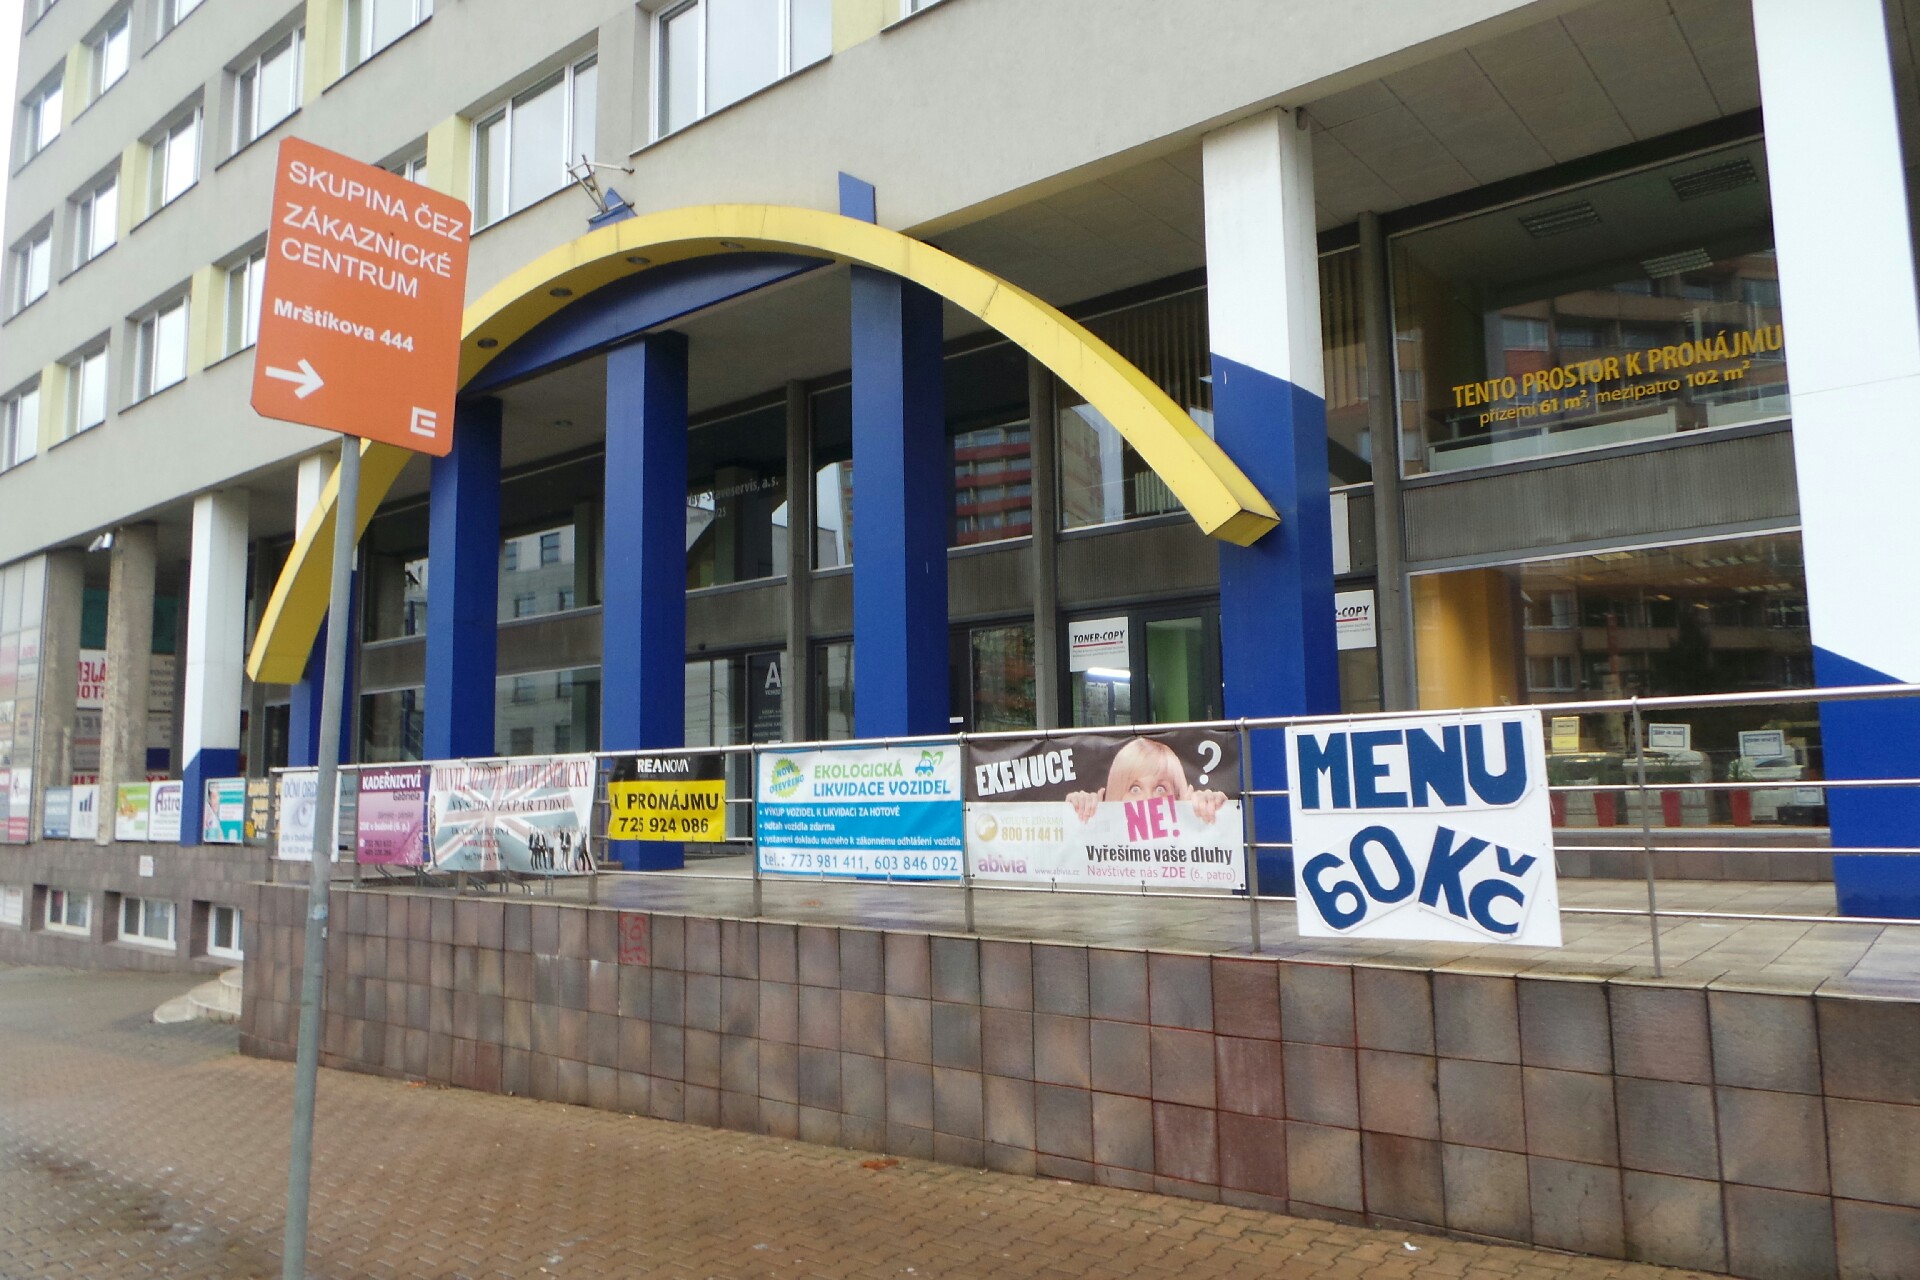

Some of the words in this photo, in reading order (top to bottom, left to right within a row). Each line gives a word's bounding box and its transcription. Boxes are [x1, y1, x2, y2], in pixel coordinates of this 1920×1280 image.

[289, 161, 408, 222] SKUPINA
[415, 203, 463, 242] ČEZ
[282, 202, 451, 278] ZÁKAZNICKÉ
[281, 238, 418, 299] CENTRUM
[380, 329, 414, 352] 444
[1453, 377, 1516, 408] TENTO
[1522, 357, 1620, 396] PROSTOR
[1626, 352, 1642, 377] K
[1647, 324, 1782, 373] PRONÁJMU
[1479, 403, 1536, 427] přízemí
[1540, 400, 1558, 413] 61
[1596, 378, 1680, 403] mezipatro
[1686, 369, 1719, 387] 102
[1723, 360, 1751, 381] m²
[762, 477, 778, 489] a.s.
[1073, 630, 1125, 644] TONER-COPY
[764, 661, 782, 688] A
[544, 760, 590, 788] ANGLICKY
[637, 757, 689, 773] REANOVA
[814, 758, 904, 779] EKOLOGICKÁ
[975, 748, 1077, 796] EXEKUCE
[1198, 740, 1222, 785] ?
[1296, 721, 1527, 809] MENU
[362, 770, 422, 790] KADEŘNICTVÍ
[813, 781, 885, 797] LIKVIDACE
[889, 779, 952, 796] VOZIDEL
[627, 789, 719, 810] PRONÁJMU
[786, 807, 815, 817] VOZIDEL
[816, 808, 822, 817] K
[822, 807, 857, 817] LIKVIDACI
[859, 807, 869, 817] ZA
[870, 805, 900, 817] HOTOVÉ
[1123, 795, 1180, 843] NE!
[618, 817, 644, 833] 725
[649, 818, 677, 833] 924
[681, 818, 709, 833] 086
[764, 821, 783, 831] odtah
[784, 822, 808, 831] vozidla
[809, 822, 835, 831] zdarma
[1002, 826, 1022, 841] 800
[1025, 827, 1036, 842] 11
[1038, 827, 1051, 842] 44
[1054, 827, 1064, 842] 11
[794, 836, 820, 845] dokladu
[821, 835, 849, 845] nutného
[850, 836, 855, 845] k
[856, 835, 896, 846] zákonnému
[897, 836, 932, 846] odhlášení
[933, 837, 961, 846] vozidla
[764, 853, 785, 867] tel.:
[790, 854, 812, 867] 773
[817, 854, 838, 868] 981
[843, 856, 869, 872] 411,
[874, 856, 898, 870] 603
[904, 856, 927, 870] 846
[932, 856, 957, 871] 092
[978, 854, 1027, 874] abivia
[1035, 865, 1080, 876] www.abivia.cz
[1086, 845, 1150, 864] Vyřešíme
[1154, 845, 1187, 864] vaše
[1190, 847, 1232, 865] dluhy
[1140, 866, 1158, 878] nás
[1162, 866, 1186, 879] ZDE
[1190, 867, 1204, 881] (6.
[1207, 868, 1236, 883] patro)
[1302, 825, 1416, 930] 60
[1418, 825, 1537, 934] Kč
